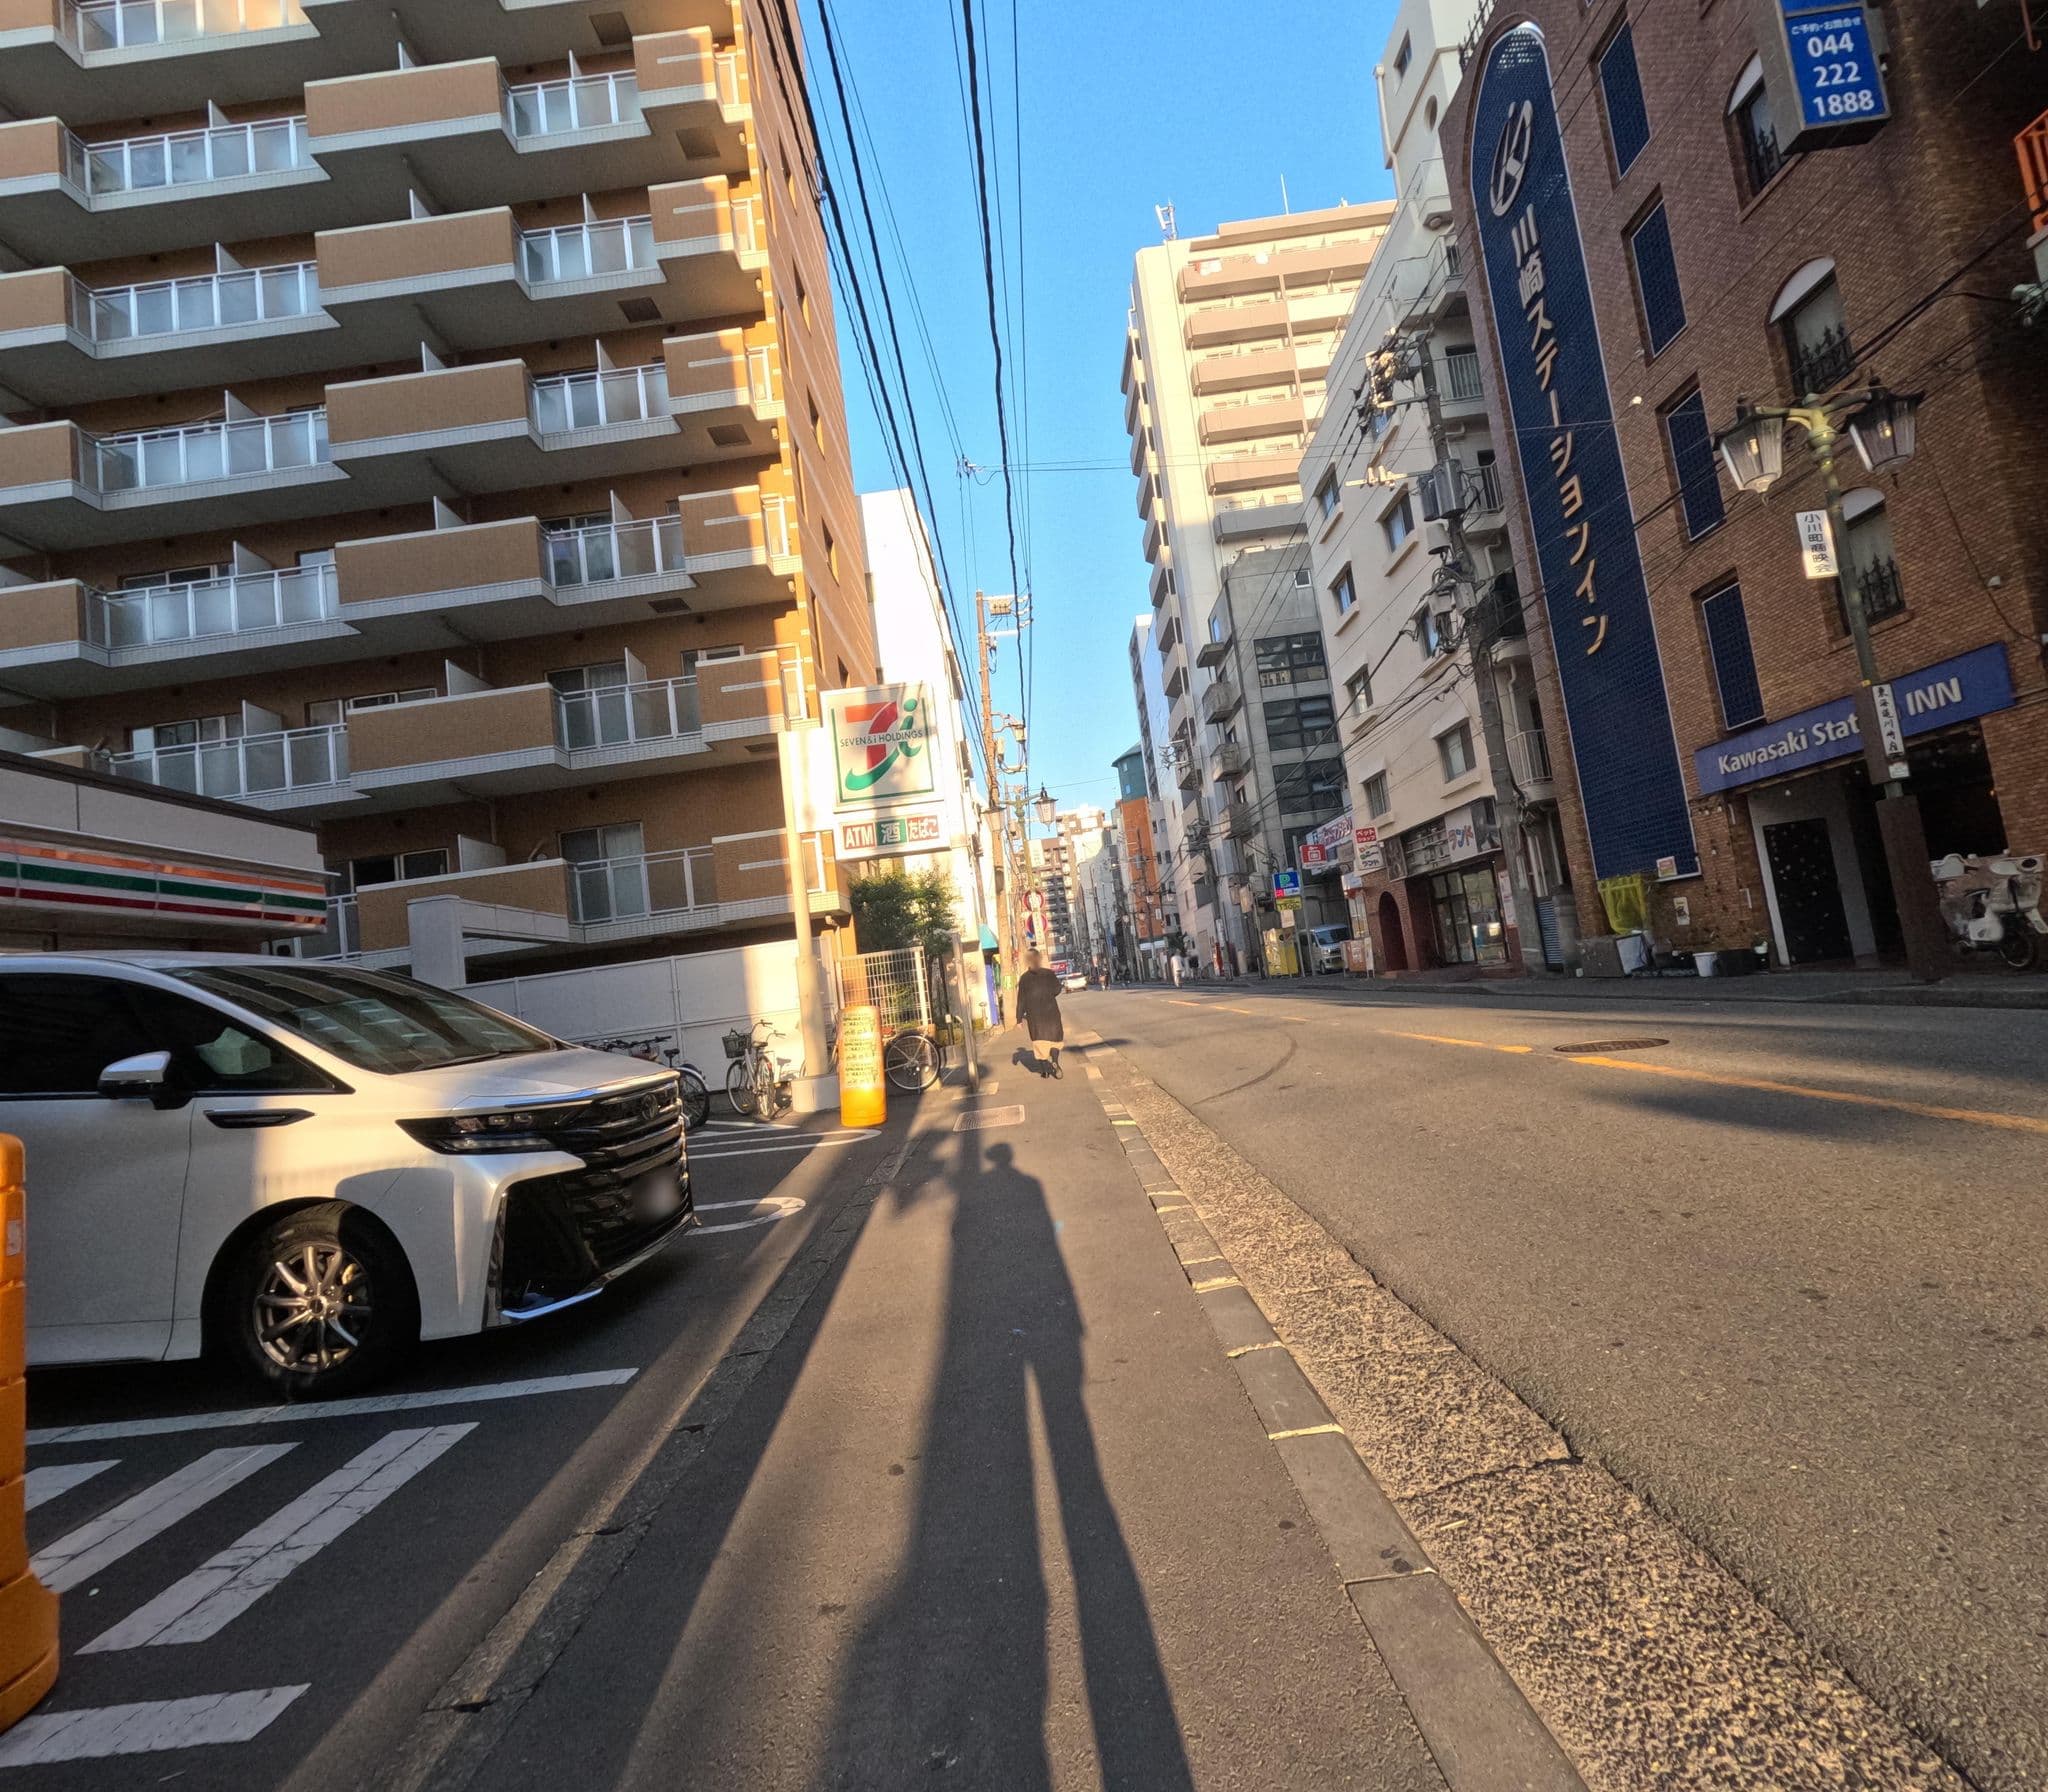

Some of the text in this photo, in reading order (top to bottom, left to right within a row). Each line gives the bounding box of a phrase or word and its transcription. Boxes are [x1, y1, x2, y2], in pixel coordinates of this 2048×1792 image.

[1792, 17, 1861, 34] ご予約・お問合せ
[1808, 32, 1854, 57] 044
[1813, 61, 1861, 87] 222
[1813, 89, 1874, 116] 1888
[879, 729, 923, 743] HOLDINGS
[1718, 677, 1961, 775] Kawasaki Stat INN
[846, 819, 938, 848] ATM 酒 たばこ
[1448, 825, 1474, 851] ランド
